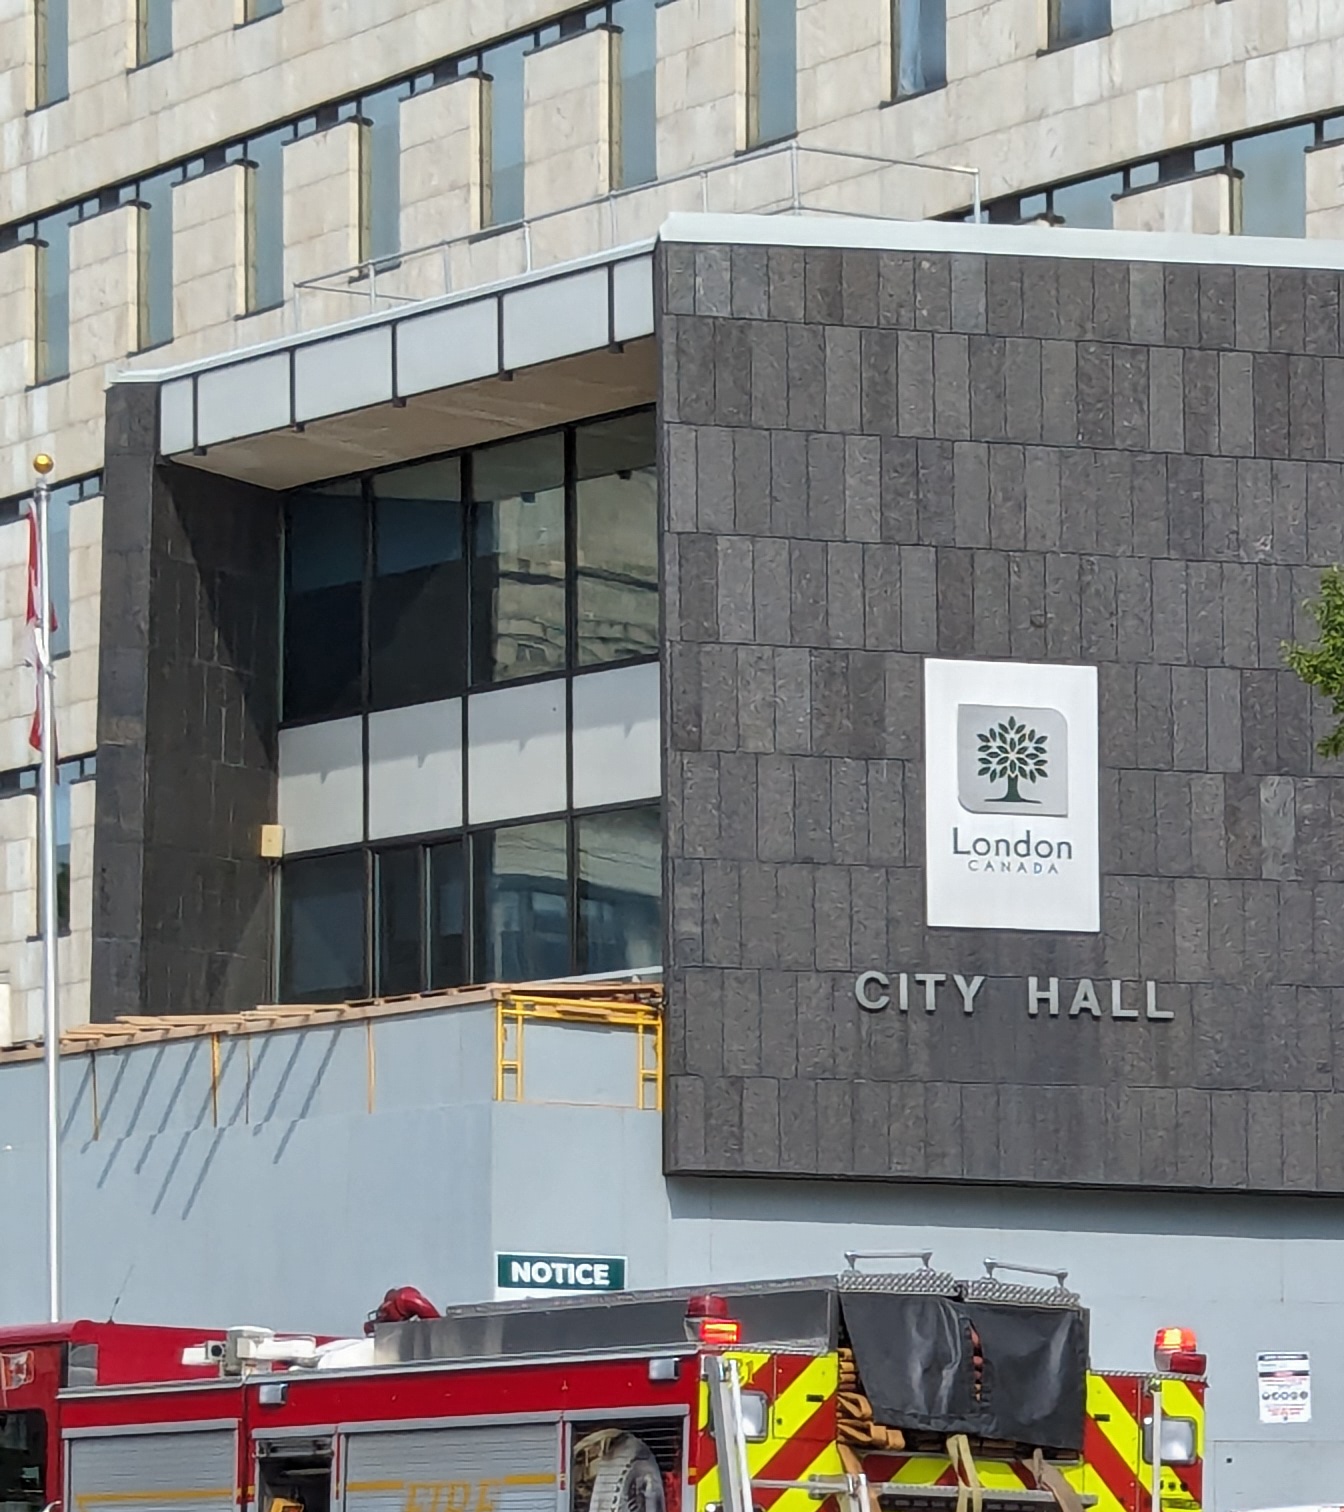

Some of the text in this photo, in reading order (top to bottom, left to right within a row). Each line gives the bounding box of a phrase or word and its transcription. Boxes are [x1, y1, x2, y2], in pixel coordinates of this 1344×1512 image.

[953, 827, 1072, 859] London
[968, 860, 1058, 874] CANADA
[855, 970, 1174, 1018] CITY HALL
[511, 1261, 610, 1285] NOTICE
